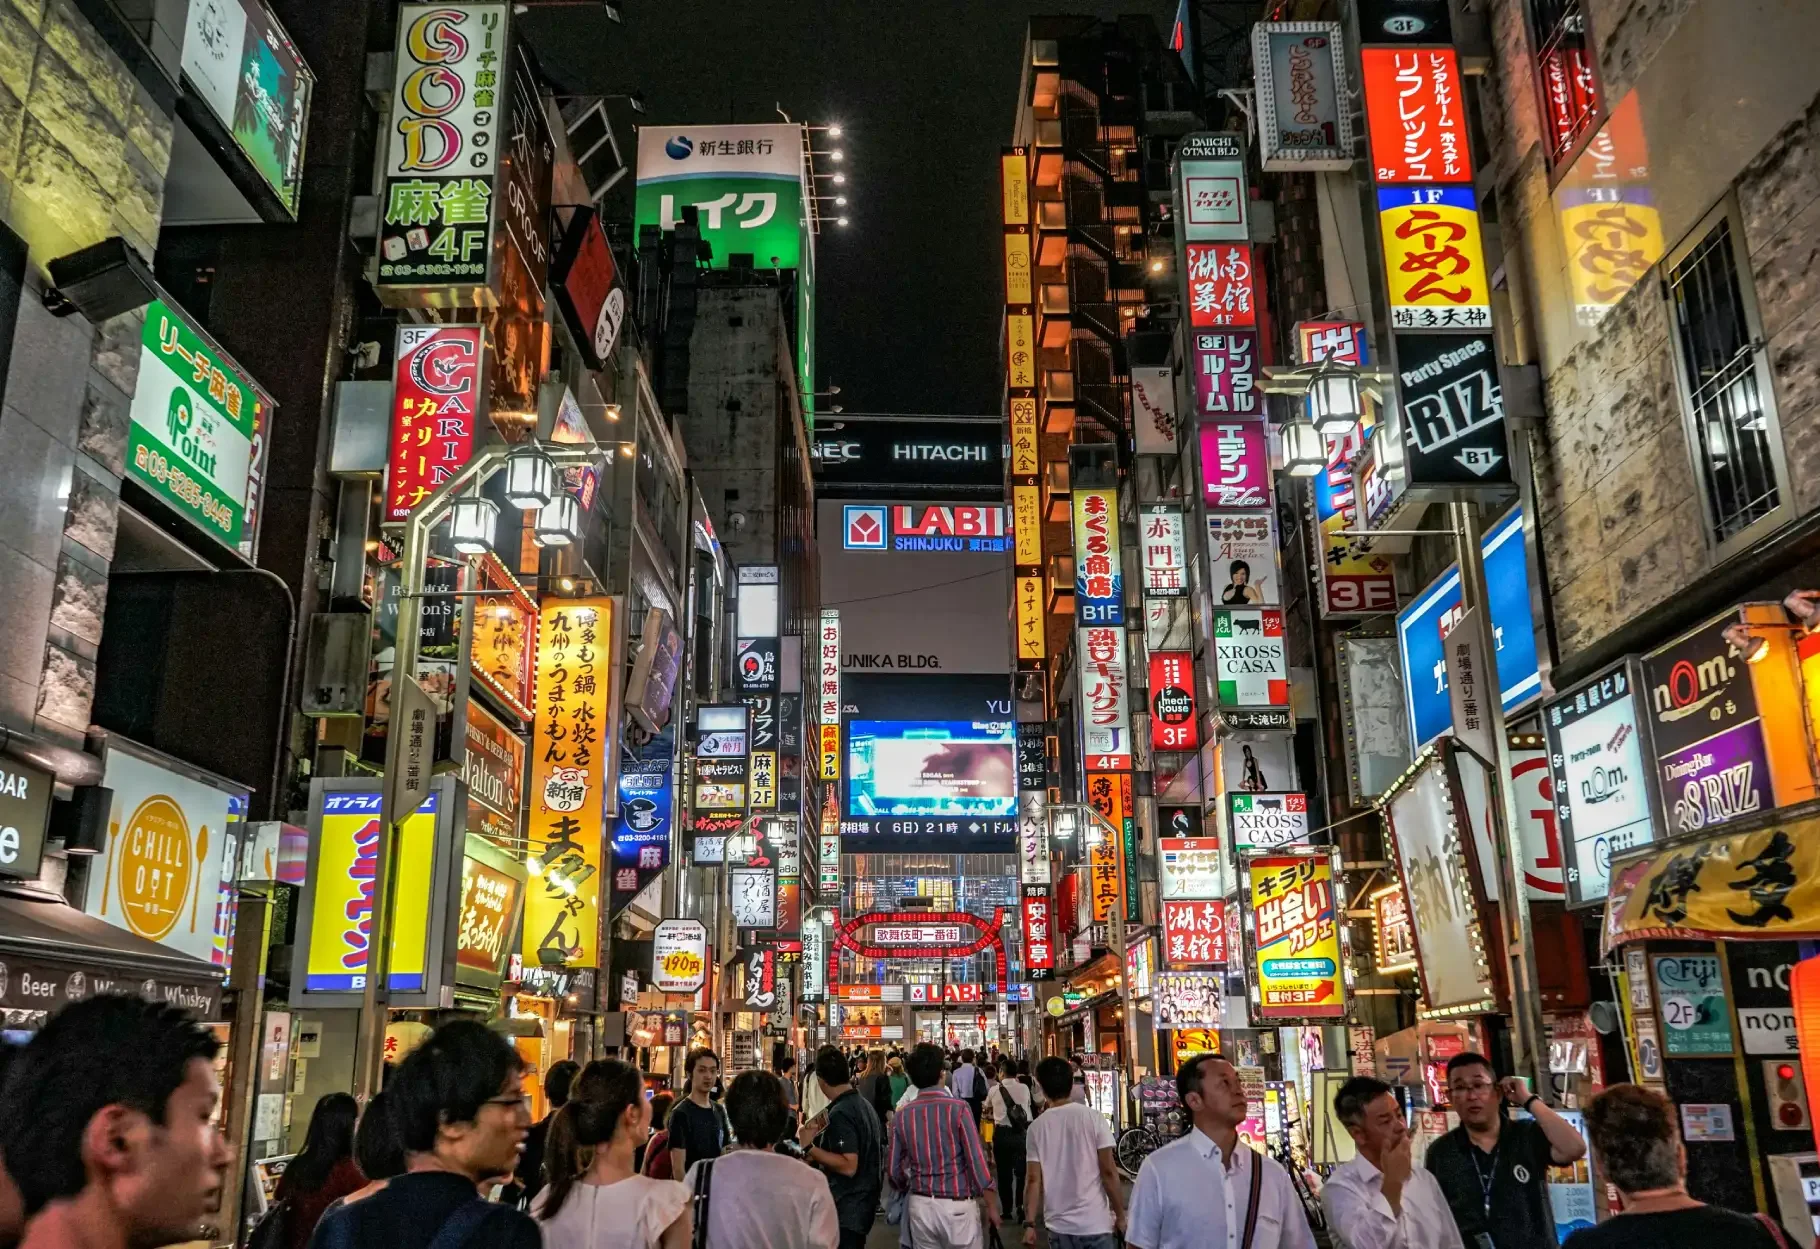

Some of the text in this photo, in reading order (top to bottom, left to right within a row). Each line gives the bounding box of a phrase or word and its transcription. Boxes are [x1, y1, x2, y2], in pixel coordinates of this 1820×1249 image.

[1393, 18, 1416, 33] 3F
[398, 9, 469, 172] GOD
[469, 12, 498, 168] リーチ麻雀 ゴッド
[1394, 52, 1433, 181] リフレッシュ
[1429, 52, 1461, 176] レンタルルーム ホステル
[699, 139, 774, 156] 新生銀行
[1013, 148, 1024, 156] 10
[1191, 138, 1232, 148] DAIICHI
[1217, 146, 1239, 156] BLD
[1377, 167, 1397, 180] 2F
[385, 179, 492, 226] 麻雀
[1410, 189, 1444, 204] 1F
[1019, 226, 1026, 234] 9
[428, 227, 485, 262] 4F
[1188, 247, 1250, 282] 湖南
[1394, 209, 1472, 304] らーめん
[393, 264, 485, 276] 03-6302-1916
[1191, 282, 1253, 314] 菜館
[1021, 307, 1028, 316] 8
[1212, 314, 1234, 325] 4F
[1393, 308, 1487, 327] 博多天神
[402, 331, 427, 345] 3F
[1200, 335, 1224, 349] 3F
[159, 316, 242, 420] リーチ麻雀
[1401, 339, 1486, 388] Party Space
[1228, 335, 1255, 412] レンタル
[1202, 354, 1229, 412] ルーム
[1024, 389, 1031, 398] 7
[1403, 368, 1503, 455] RIZ
[166, 386, 217, 478] Point
[395, 398, 415, 507] 個室ダイニング
[409, 398, 439, 508] カリーナ
[893, 444, 987, 461] HITACHI
[1015, 436, 1036, 472] 魚金
[1466, 451, 1492, 465] B1
[1027, 476, 1034, 486] 6
[147, 450, 232, 532] 03-5285-3445
[1218, 486, 1267, 507] Eden
[1152, 505, 1167, 514] 4F
[893, 505, 1004, 536] LABI
[1017, 493, 1033, 557] ちびすけバル
[1222, 517, 1268, 530] タイ古式
[895, 537, 963, 551] SHINJUKU
[1146, 517, 1173, 567] 赤門
[1209, 530, 1269, 542] マッサージ
[1083, 495, 1112, 599] まぐろ商店
[1031, 567, 1038, 577] 5
[1330, 580, 1392, 609] 3F
[1082, 604, 1120, 621] B1F
[1216, 616, 1229, 627] 肉
[1022, 594, 1040, 657] すずや
[1218, 645, 1282, 659] XROSS
[897, 654, 942, 669] BLDG.
[1034, 661, 1041, 670] 4
[1226, 659, 1277, 674] CASA
[822, 626, 838, 716] お好み焼き
[543, 610, 572, 764] 九州のうまかもん
[571, 607, 599, 767] 博多もつ鍋 水炊き
[1456, 643, 1480, 730] 劇場通り一番街
[1158, 700, 1190, 721] house
[1228, 713, 1289, 726] 第一大滝ビル
[822, 726, 837, 752] 麻雀
[1163, 727, 1189, 746] 3F
[1096, 756, 1121, 770] 4F
[1552, 753, 1565, 768] 5F
[753, 753, 773, 788] 麻雀
[624, 774, 663, 789] BLUE
[1023, 778, 1044, 787] 3F
[1555, 779, 1568, 793] 4F
[753, 790, 773, 804] 2F
[1234, 797, 1244, 808] 肉
[1239, 814, 1303, 829] XROSS
[1558, 806, 1571, 821] 3F
[624, 834, 668, 842] 03-3200-4181
[1248, 828, 1299, 843] CASA
[132, 826, 183, 868] CHILL
[1183, 841, 1198, 849] 2F
[1257, 858, 1316, 898] キラリ
[1567, 867, 1580, 884] 2F
[1027, 886, 1047, 897] 焼肉
[1169, 903, 1222, 933] 湖南
[1257, 881, 1328, 943] 出会い
[876, 928, 960, 942] 歌舞伎町一番街
[1289, 918, 1334, 956] カフェ
[1170, 934, 1211, 961] 菜館
[1211, 935, 1225, 960] 4F
[664, 955, 701, 973] 190円
[1032, 968, 1047, 978] 2F
[1679, 959, 1717, 988] Fiji
[21, 972, 57, 998] Beer
[927, 984, 983, 1002] LABI
[164, 986, 213, 1014] Whiskey
[1267, 990, 1317, 1004] 受付3F
[1667, 1001, 1694, 1025] 2F
